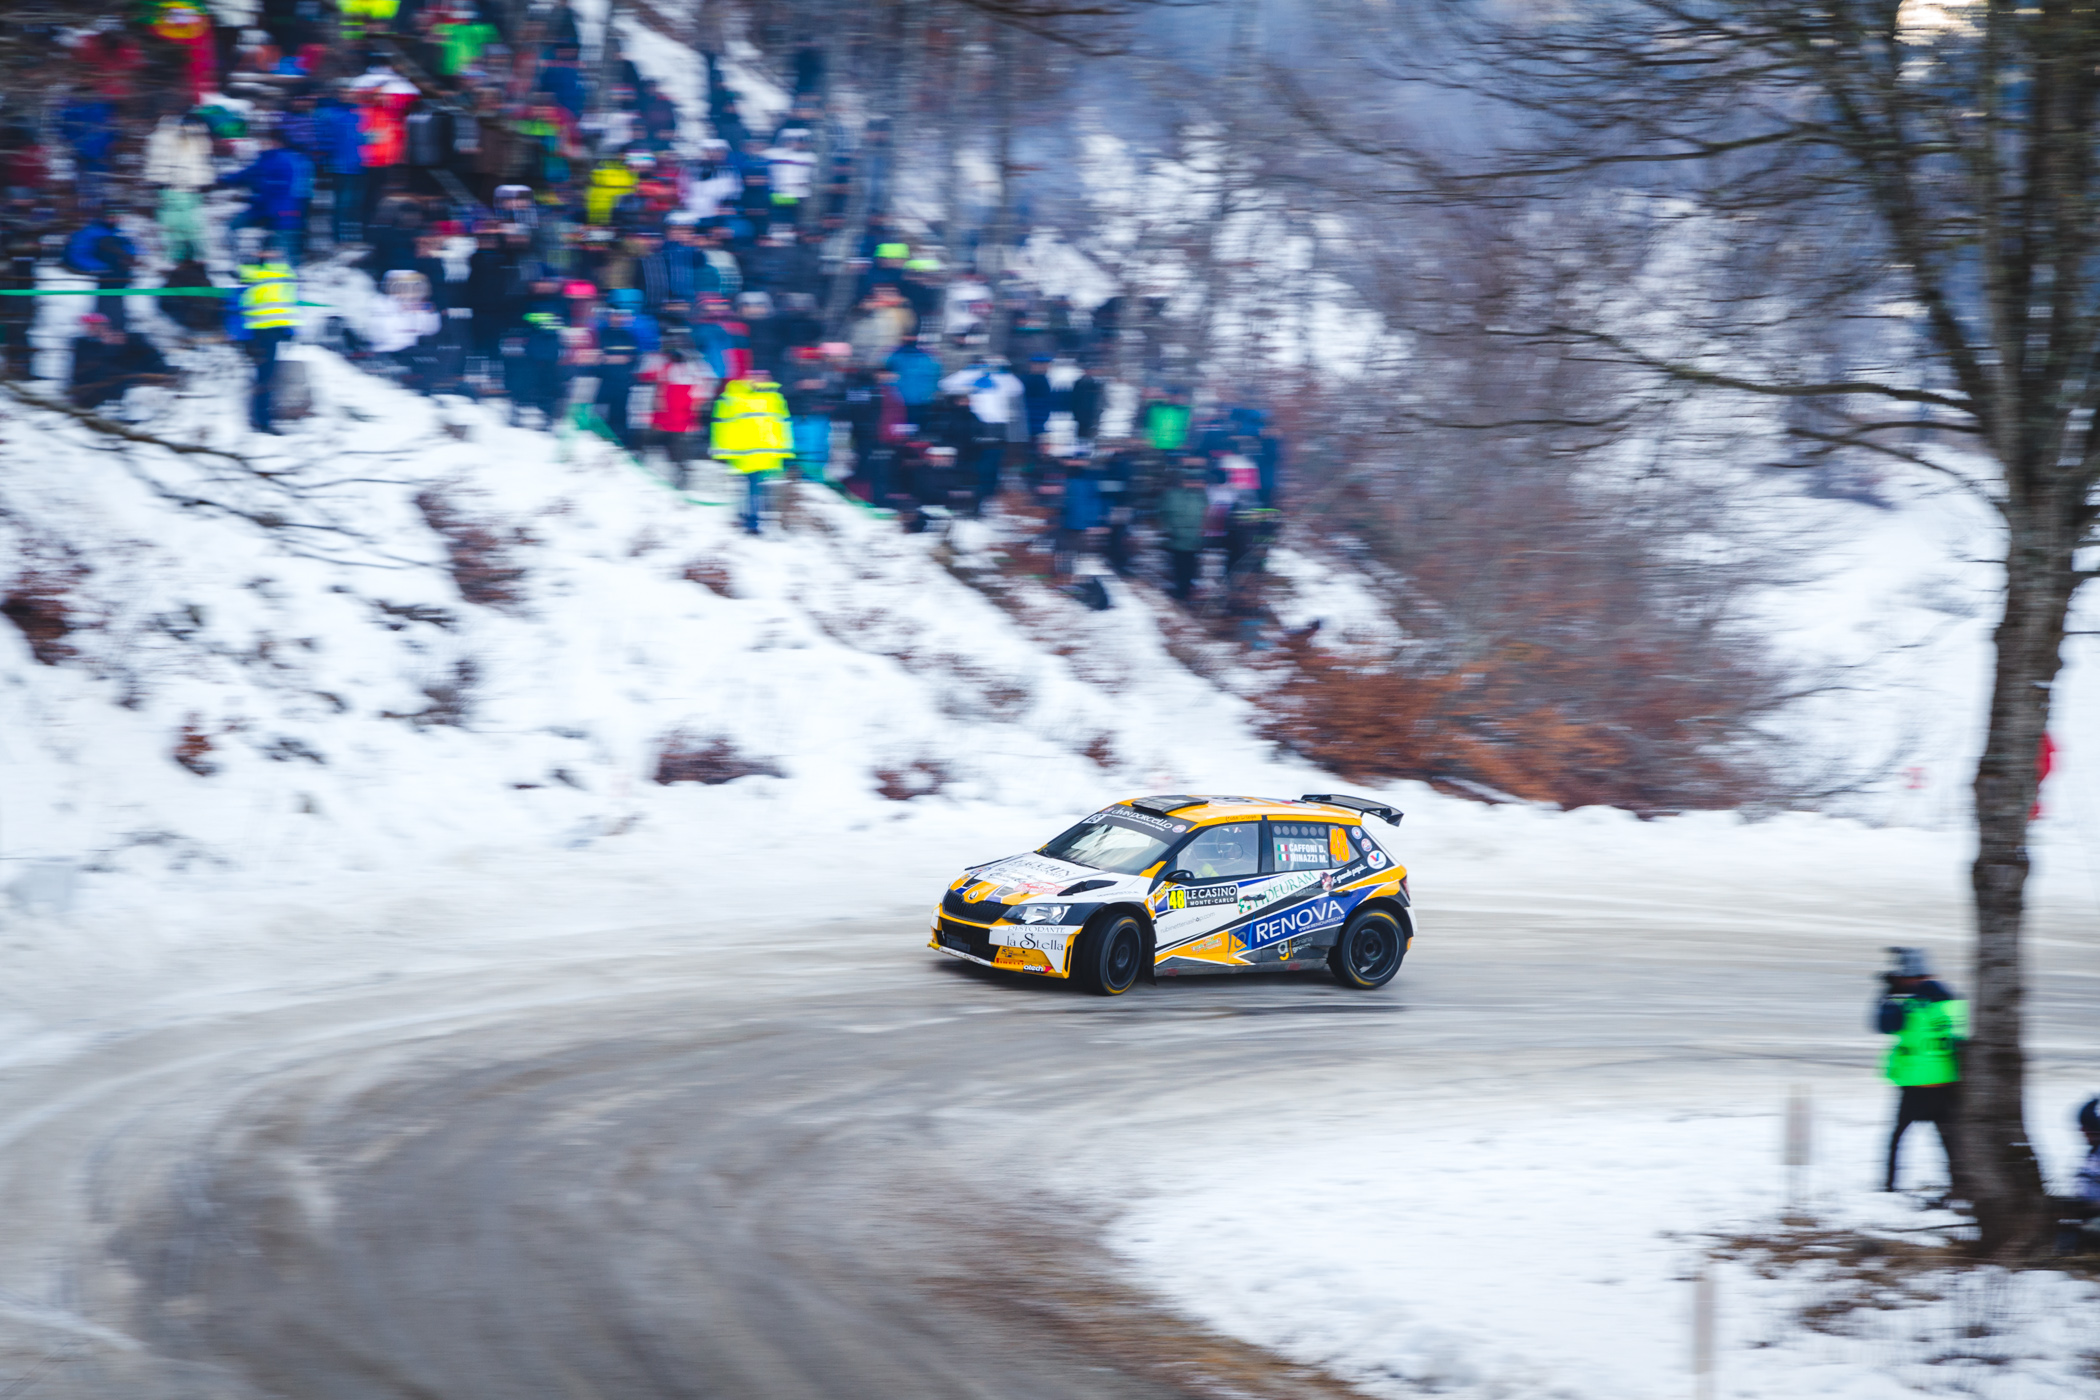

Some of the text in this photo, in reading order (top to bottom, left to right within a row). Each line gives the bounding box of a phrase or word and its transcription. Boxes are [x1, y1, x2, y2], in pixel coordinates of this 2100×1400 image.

[1288, 843, 1318, 853] CAFFONI
[1330, 827, 1350, 862] 48
[1290, 854, 1318, 863] MINAZZI
[1169, 889, 1185, 909] 48
[1186, 886, 1236, 900] LE CASINO
[1256, 900, 1345, 943] RENOVA
[1006, 932, 1064, 951] la Stella
